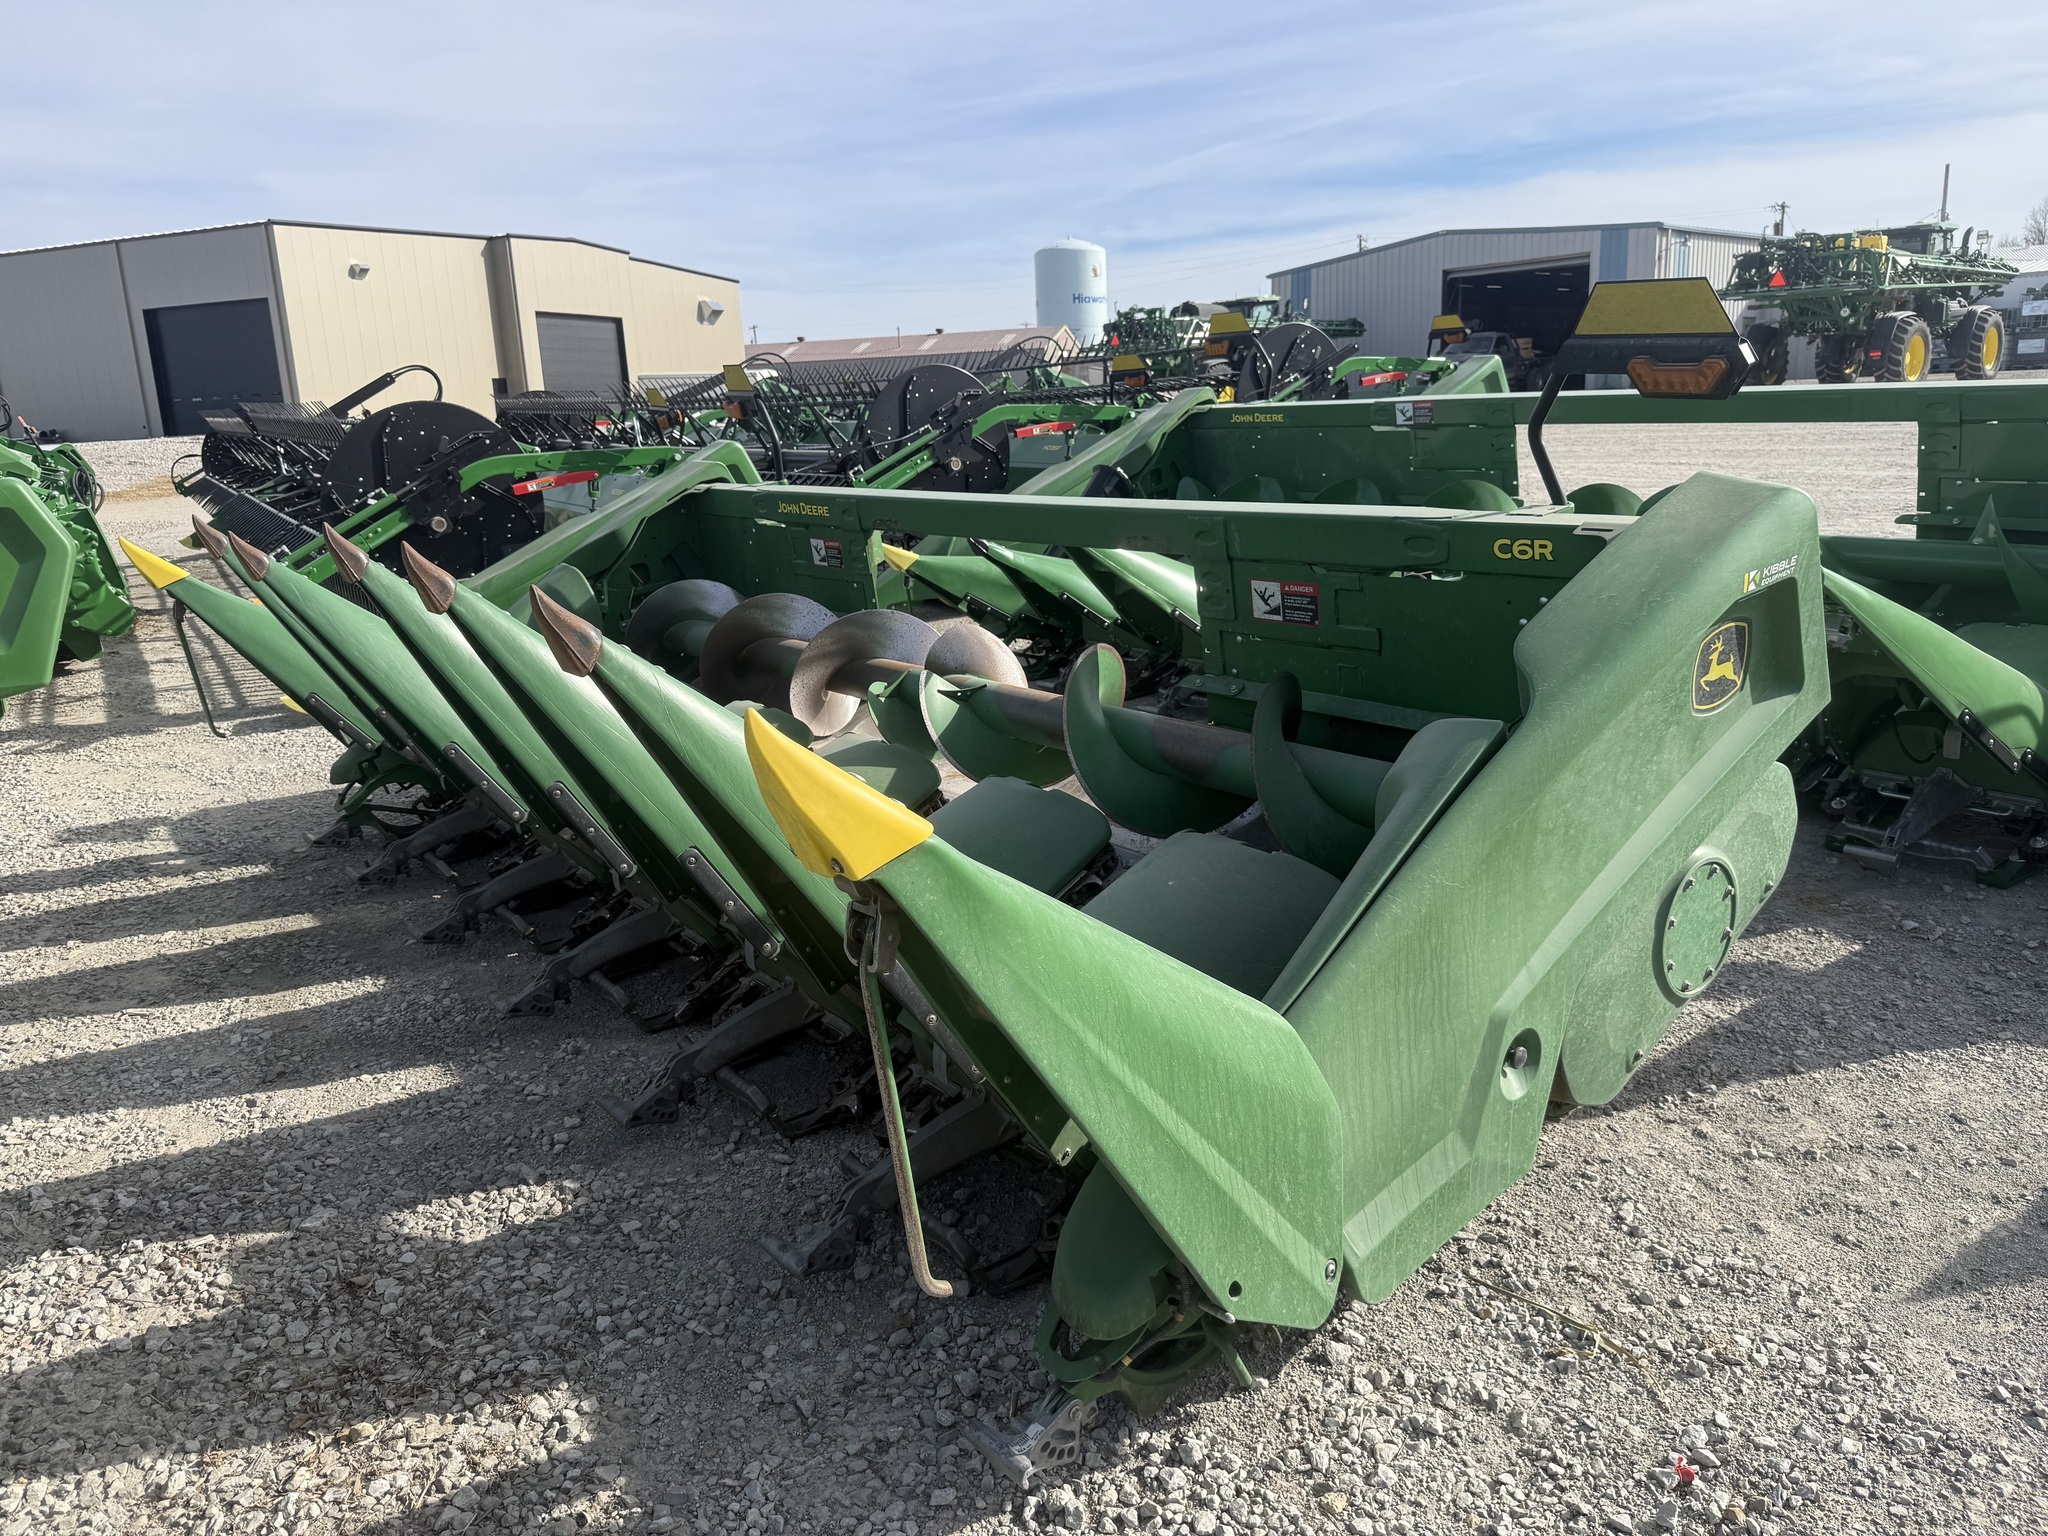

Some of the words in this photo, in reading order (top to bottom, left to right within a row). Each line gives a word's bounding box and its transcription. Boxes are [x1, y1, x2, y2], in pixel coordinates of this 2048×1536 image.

[1230, 413, 1253, 423] JOHN
[1254, 413, 1284, 422] DEERE
[778, 500, 800, 514] JOHN
[800, 502, 830, 517] DEERE
[1492, 538, 1554, 561] C6R
[1762, 555, 1798, 578] KIBBLE
[1289, 584, 1314, 593] DANGER
